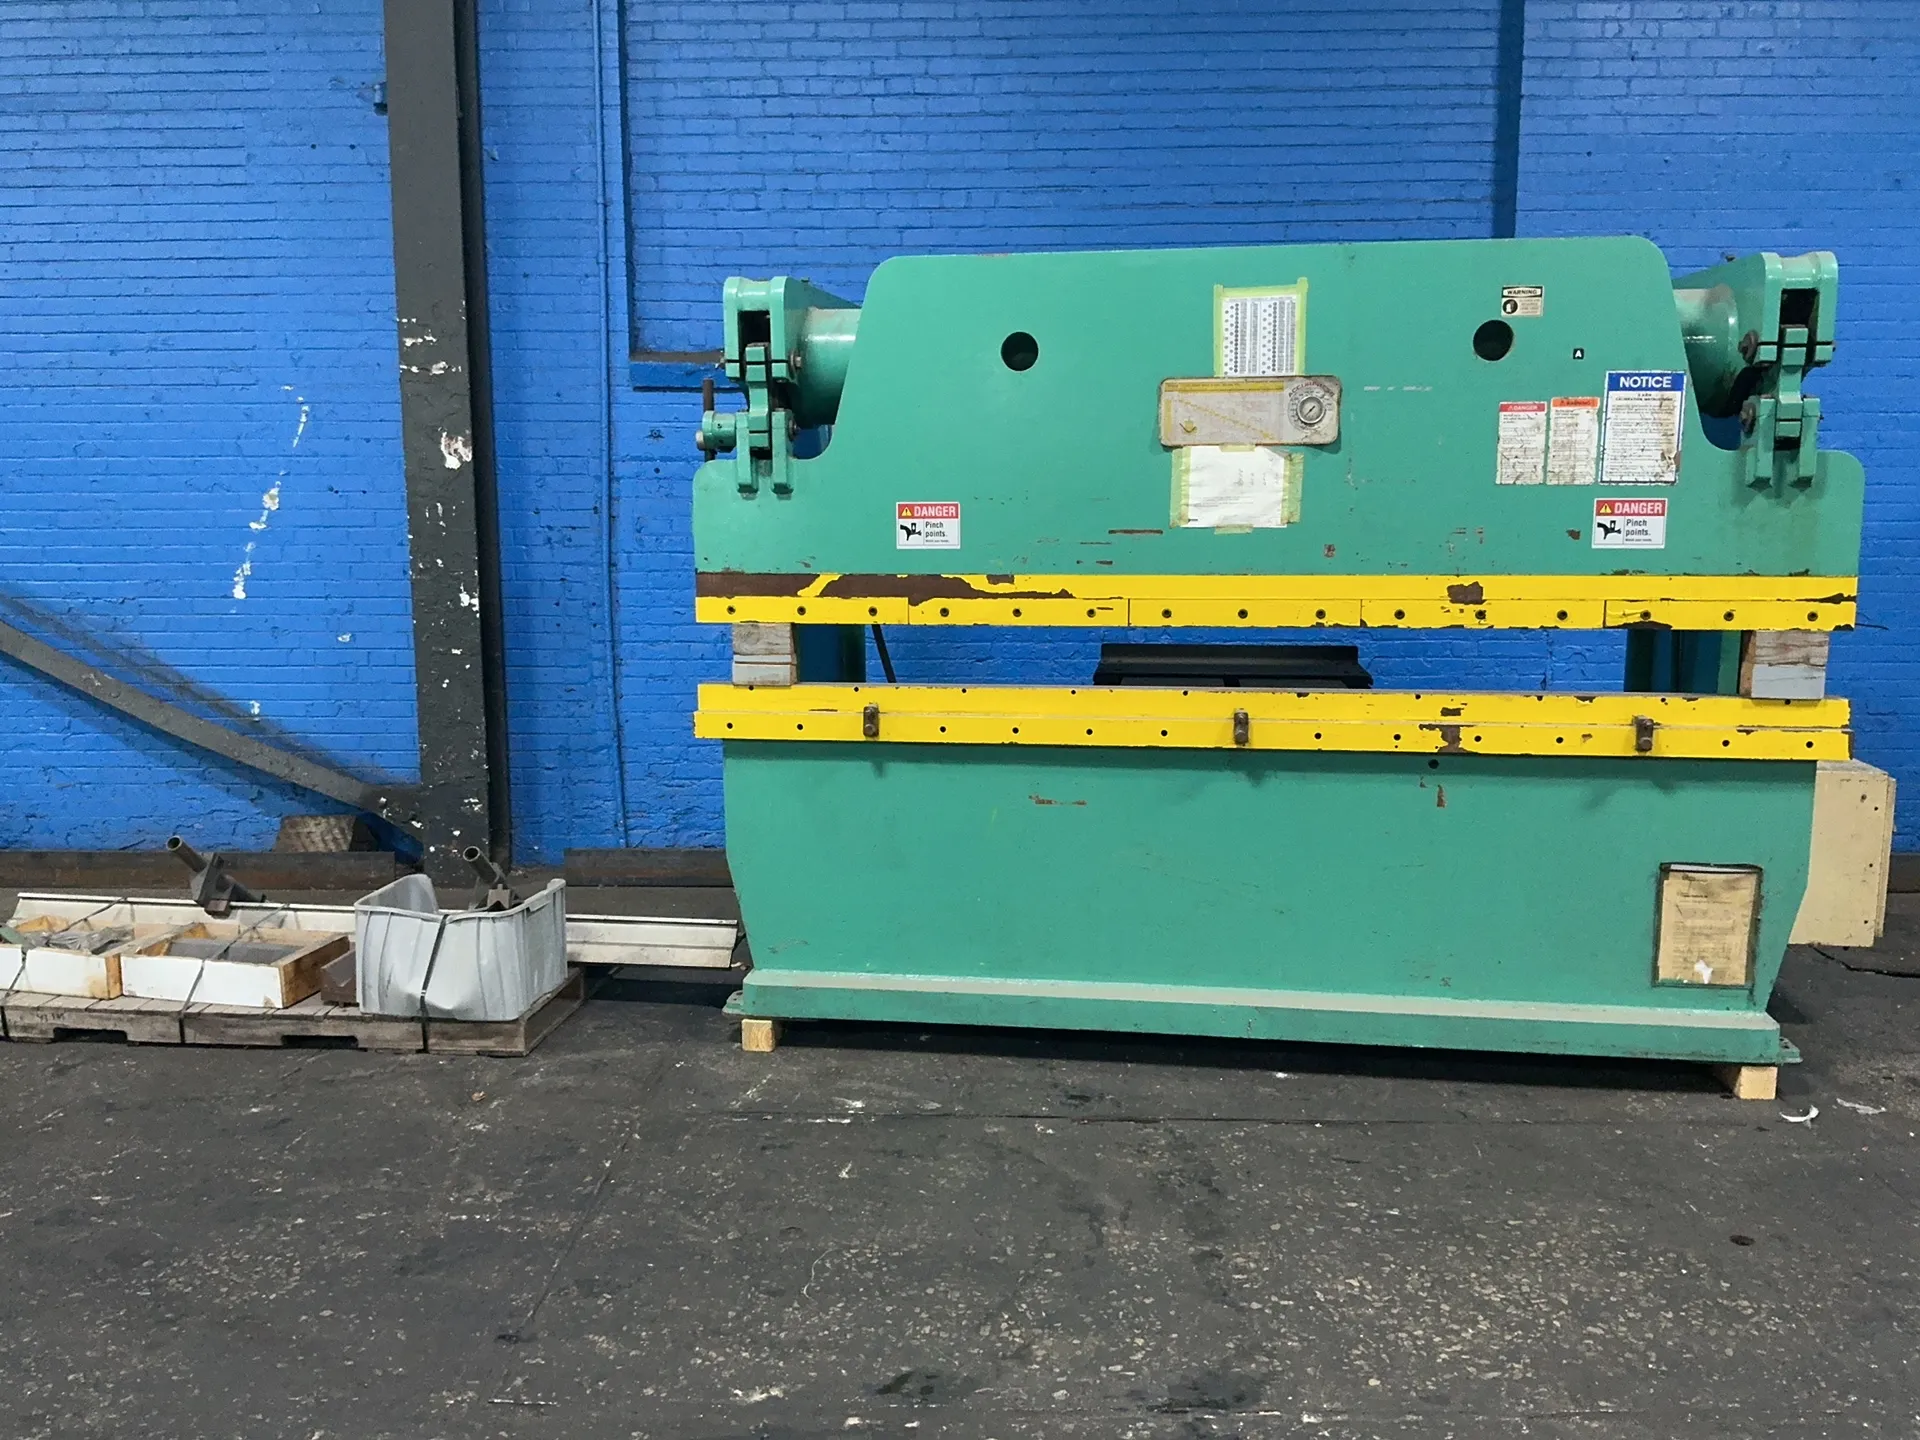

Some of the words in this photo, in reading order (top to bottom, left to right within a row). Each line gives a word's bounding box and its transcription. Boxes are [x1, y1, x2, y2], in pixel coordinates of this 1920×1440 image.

[1574, 349, 1582, 358] A
[1619, 376, 1672, 388] NOTICE
[913, 505, 956, 517] DANGER
[1614, 502, 1663, 514] DANGER
[925, 521, 944, 529] Pinch
[1626, 518, 1648, 527] Pinch
[925, 530, 948, 538] points.
[1625, 528, 1651, 537] points.
